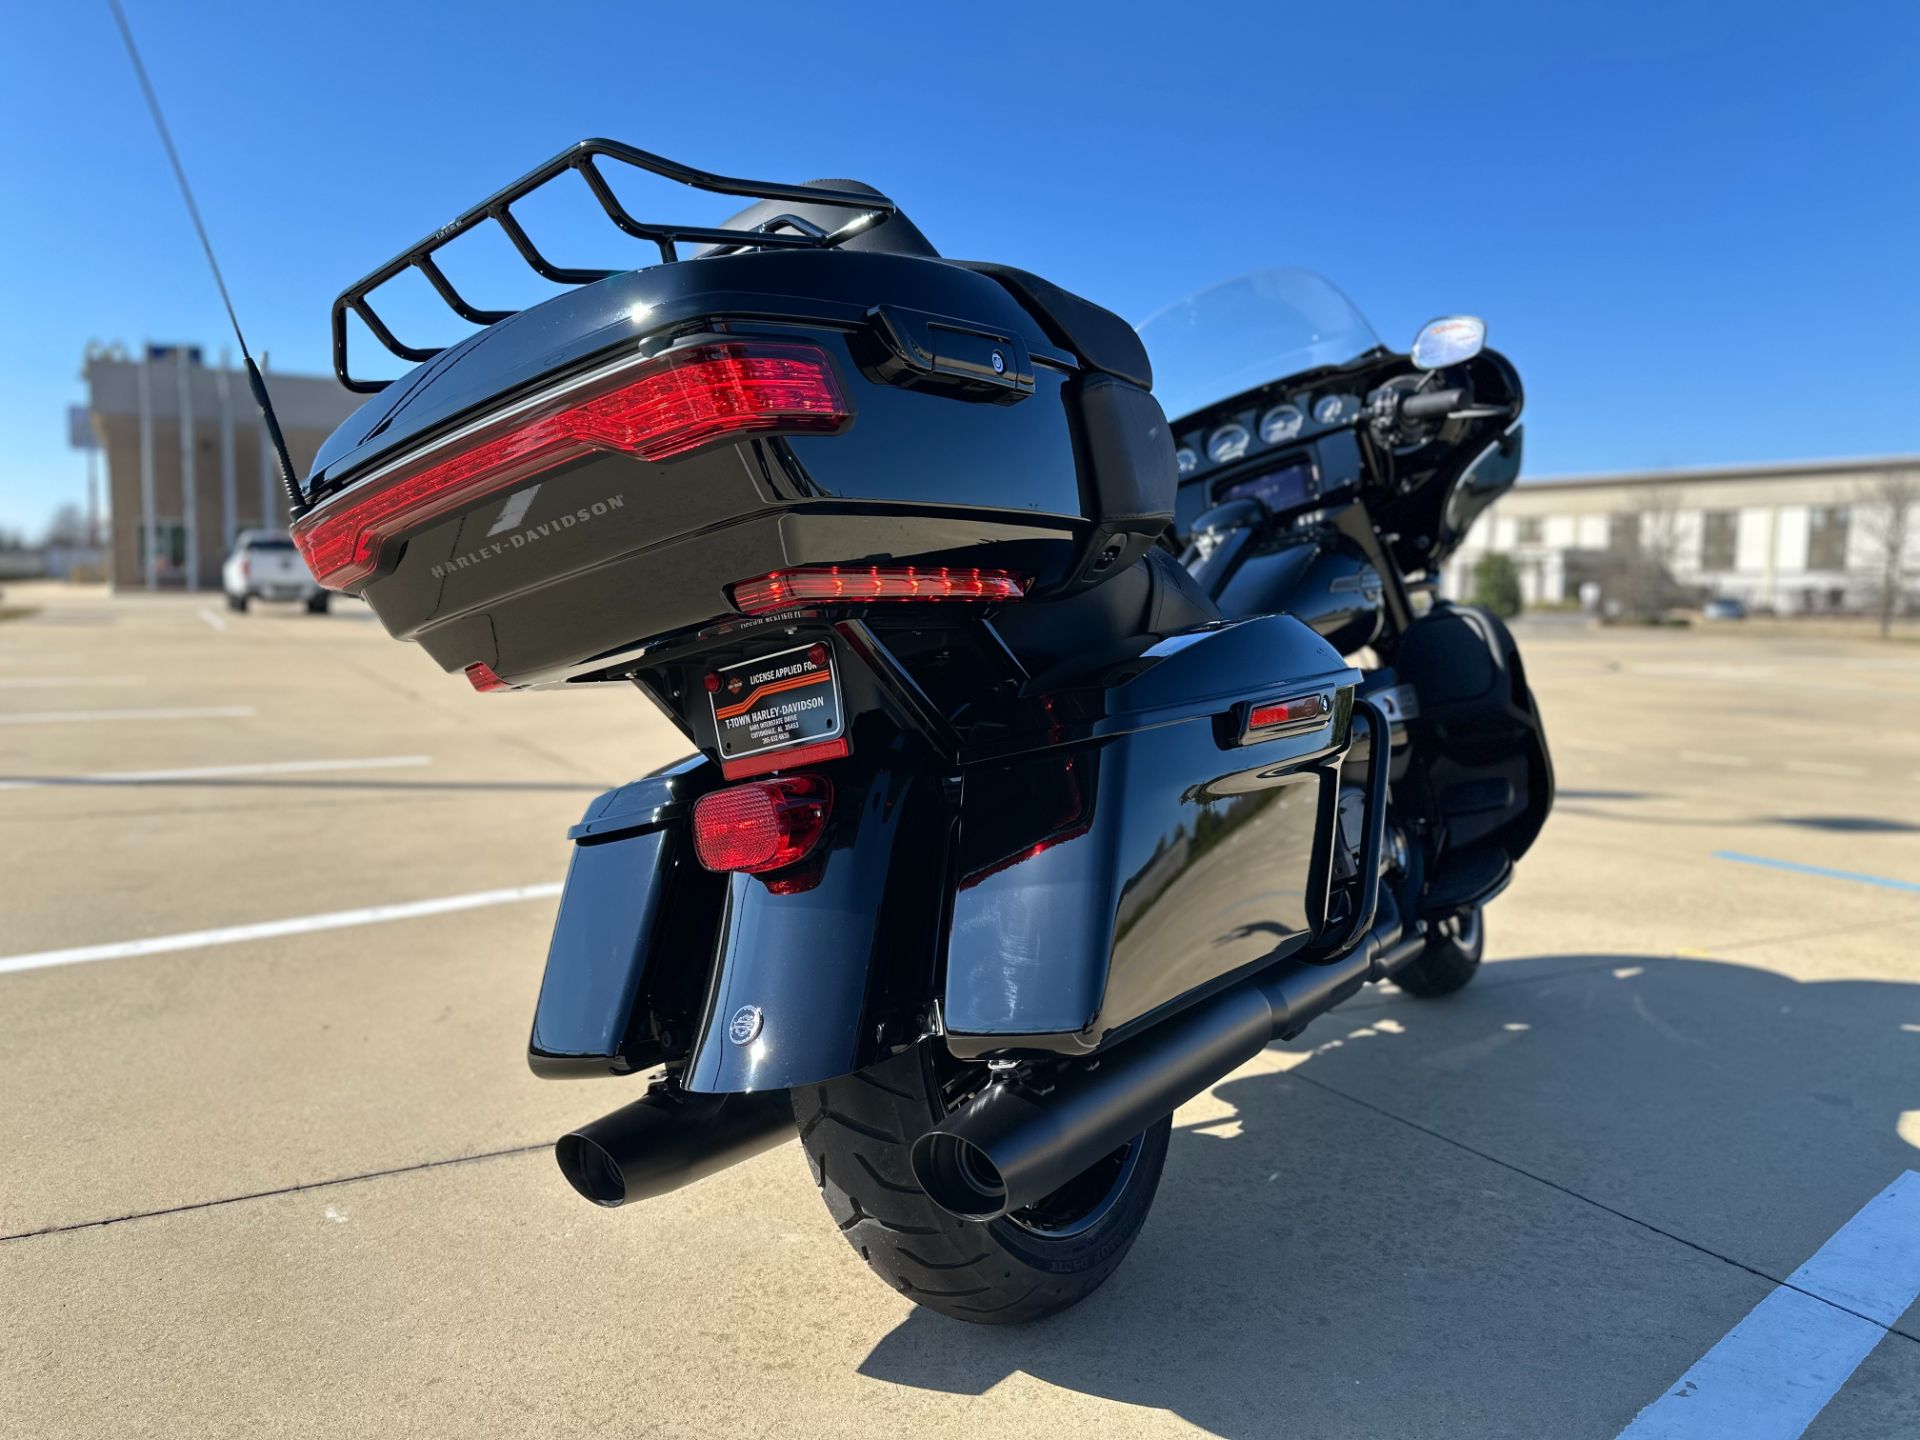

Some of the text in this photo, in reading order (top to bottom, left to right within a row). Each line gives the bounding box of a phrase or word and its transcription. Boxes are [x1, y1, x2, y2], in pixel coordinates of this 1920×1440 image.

[430, 495, 624, 579] HARLEY-DAVIDSON
[750, 669, 775, 685] LICENSE
[775, 663, 802, 679] APPLIED
[725, 696, 824, 730] T-TOWN HARLEY-DAVIDSON
[784, 713, 798, 724] DRIVE
